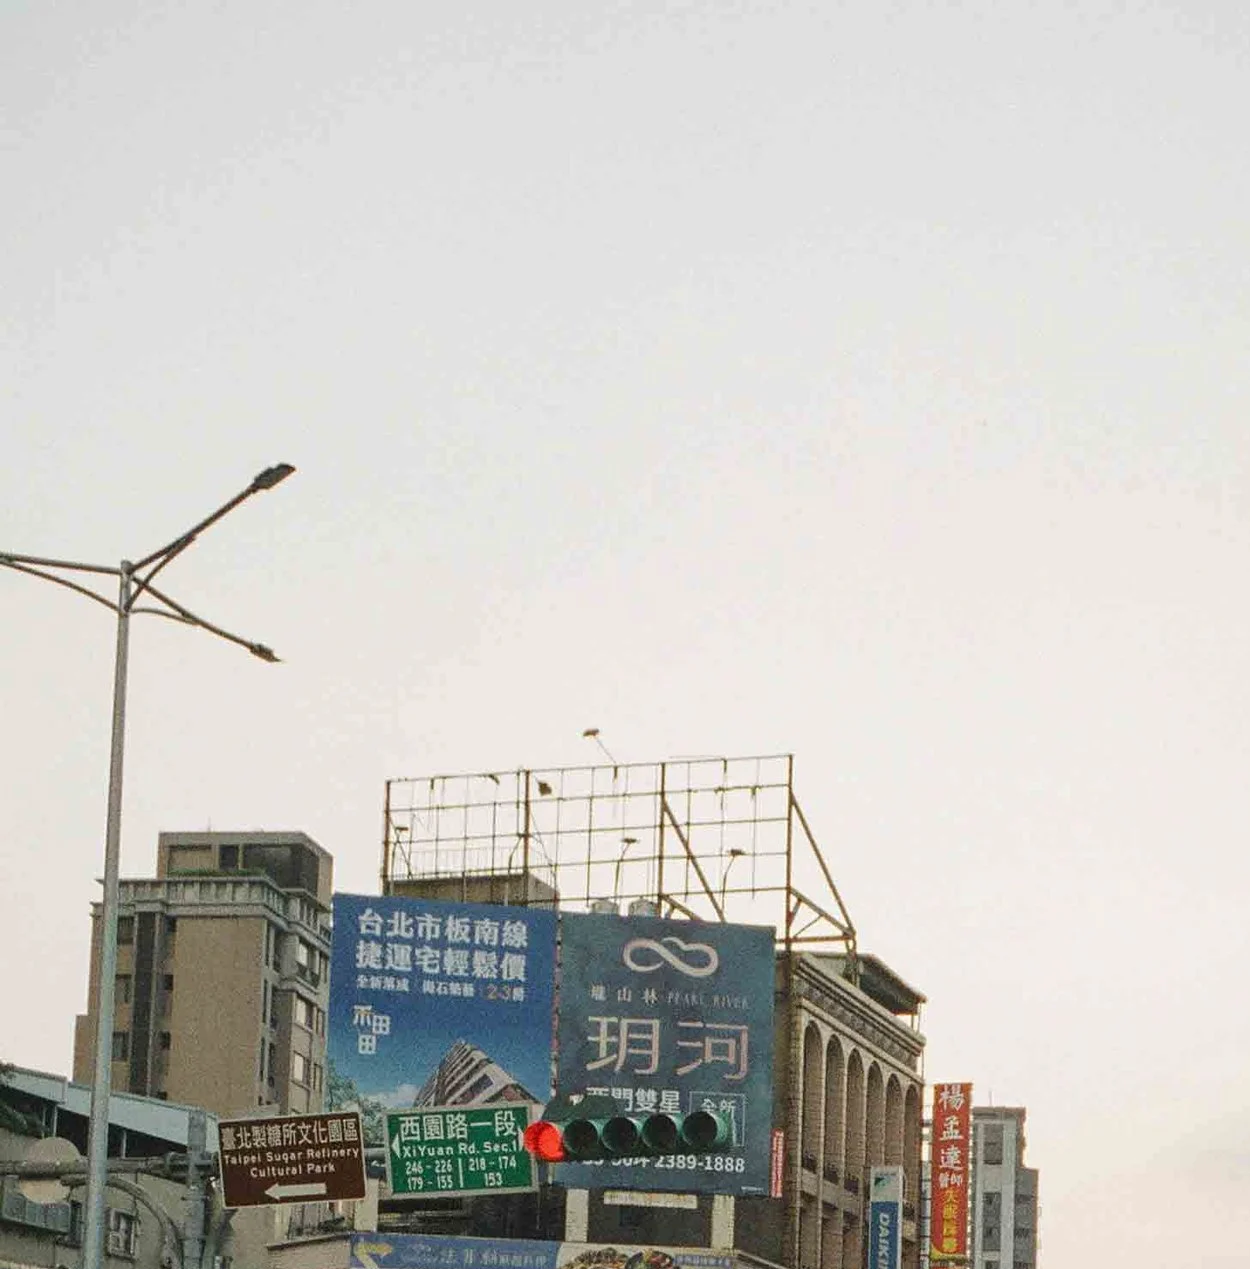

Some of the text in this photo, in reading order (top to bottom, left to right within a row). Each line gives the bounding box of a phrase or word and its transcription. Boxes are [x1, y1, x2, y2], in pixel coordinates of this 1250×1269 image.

[358, 908, 528, 948] 台北市板南線
[587, 1016, 748, 1081] 玥河
[400, 1110, 517, 1142] 西園路一段
[224, 1147, 359, 1166] Taipei Sugar Refinery
[402, 1144, 454, 1157] XiYuan
[459, 1143, 479, 1155] Rd.
[250, 1162, 336, 1178] Cultural Park
[484, 1172, 503, 1187] 153
